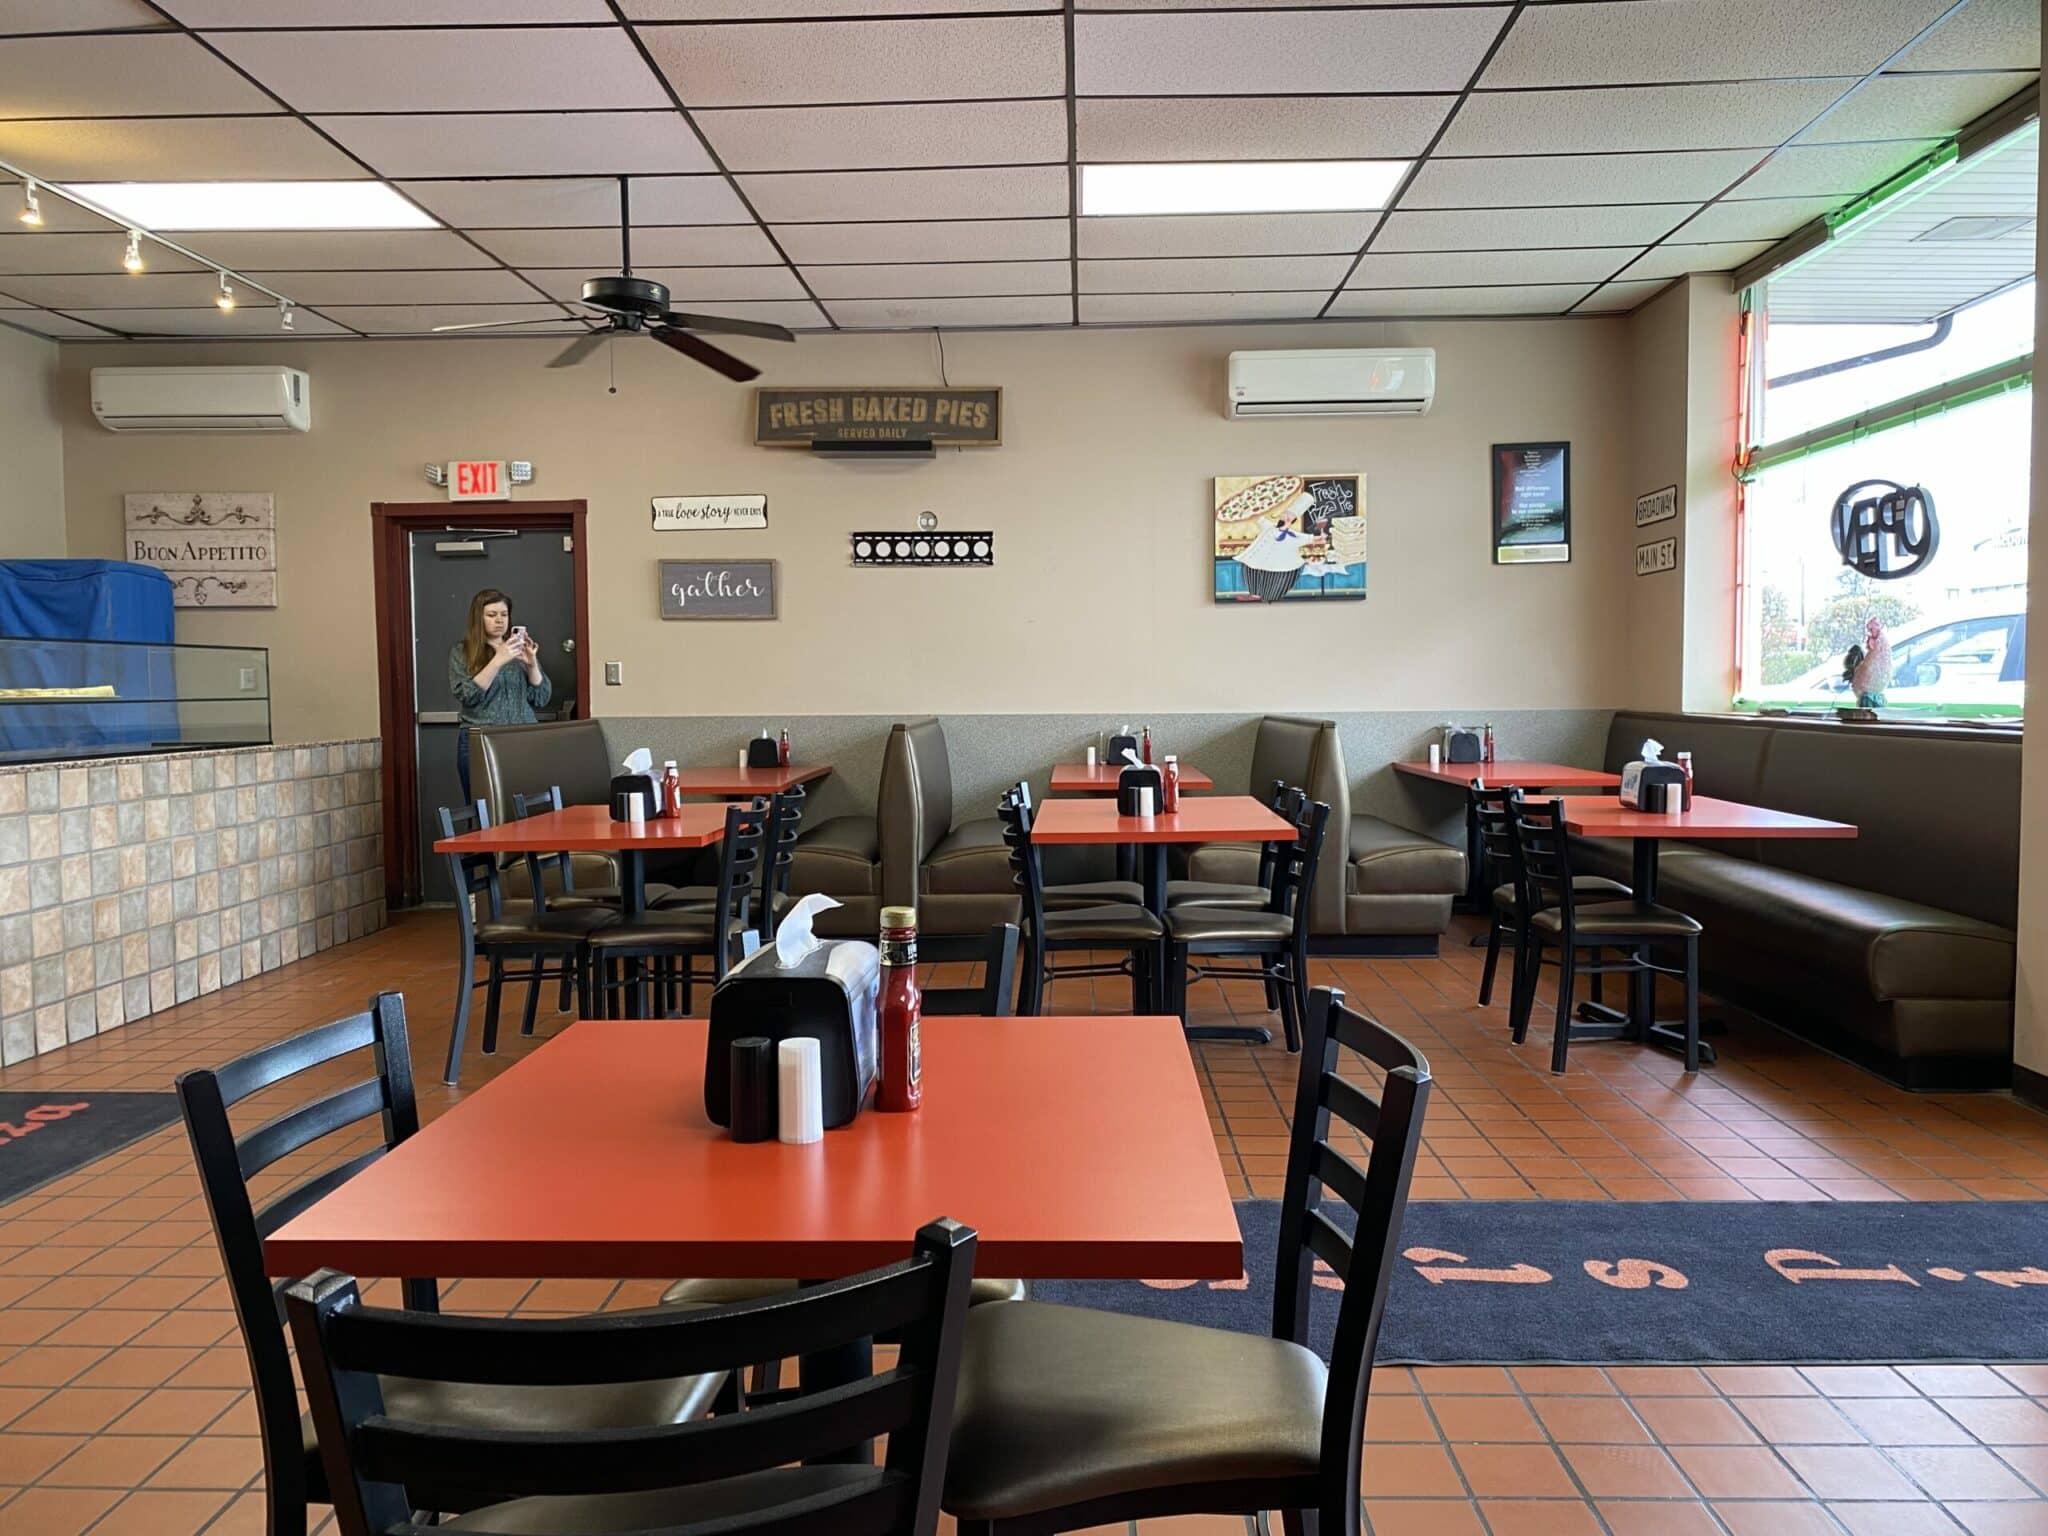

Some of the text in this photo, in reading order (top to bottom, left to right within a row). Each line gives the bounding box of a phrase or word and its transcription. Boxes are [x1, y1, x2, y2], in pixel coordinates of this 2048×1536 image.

[770, 397, 990, 428] FRESH BAKED PIES
[838, 427, 907, 439] SERVED DAILY
[458, 462, 498, 495] EXIT
[1309, 480, 1353, 502] Fresh
[675, 502, 699, 520] love
[700, 503, 731, 524] story
[1639, 492, 1674, 521] BROADWAY
[1639, 547, 1658, 570] MAIN
[671, 570, 766, 607] gather
